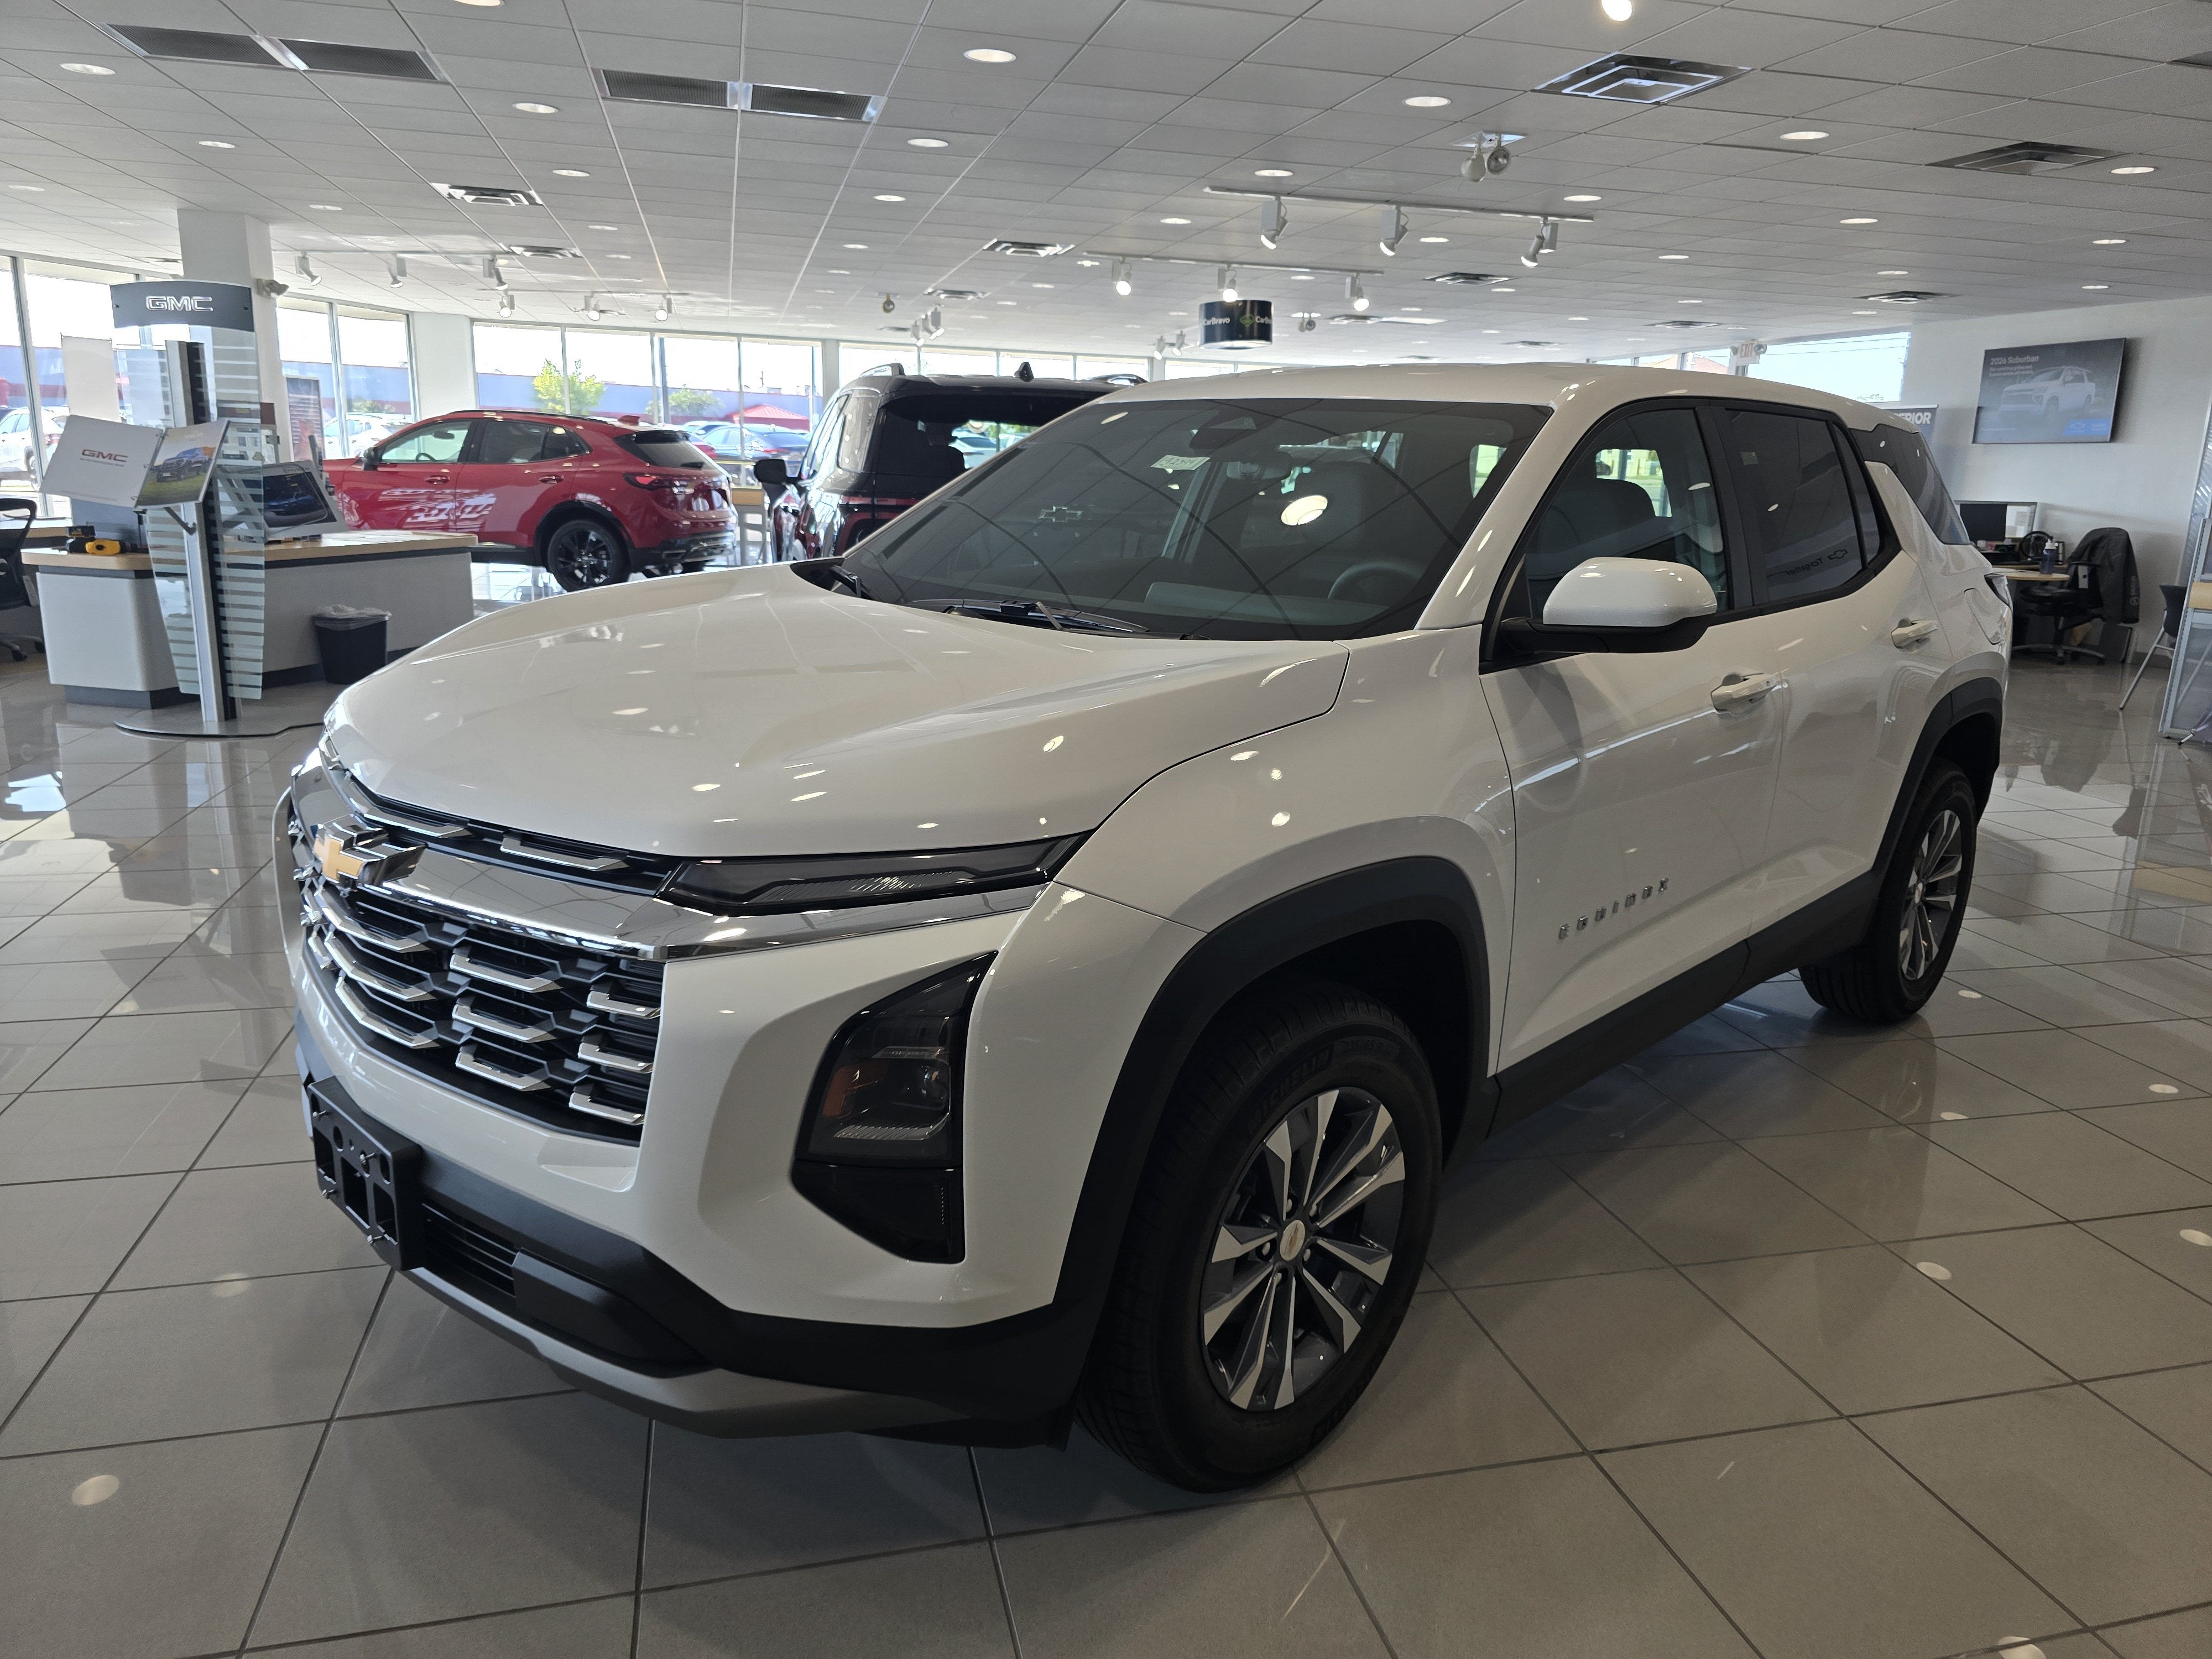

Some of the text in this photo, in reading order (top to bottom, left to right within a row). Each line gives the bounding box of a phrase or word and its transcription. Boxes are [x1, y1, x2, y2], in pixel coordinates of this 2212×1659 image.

[145, 296, 213, 311] GMC
[2007, 355, 2039, 364] Suburban
[81, 448, 128, 462] GMC
[1558, 877, 1669, 940] EQUINOX
